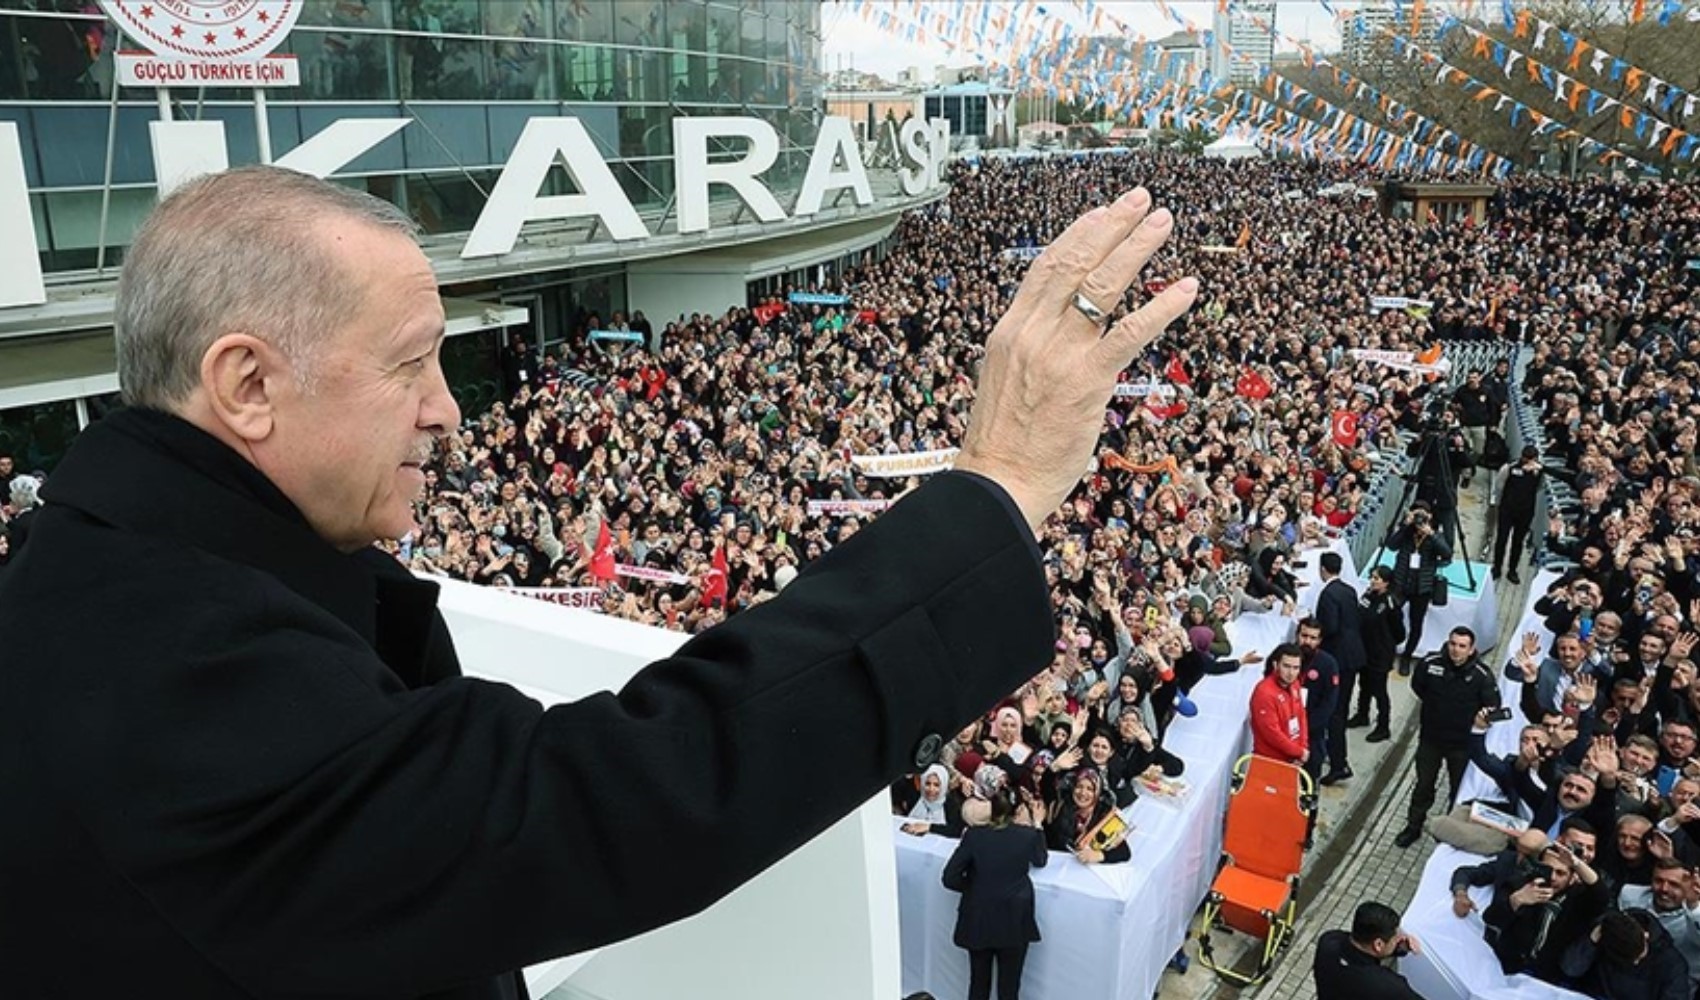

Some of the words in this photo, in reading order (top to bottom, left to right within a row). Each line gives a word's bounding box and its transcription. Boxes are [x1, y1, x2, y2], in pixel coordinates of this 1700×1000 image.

[134, 61, 185, 83] GÜÇLÜ
[190, 61, 253, 80] TÜRKİYE
[256, 62, 285, 83] İÇİN
